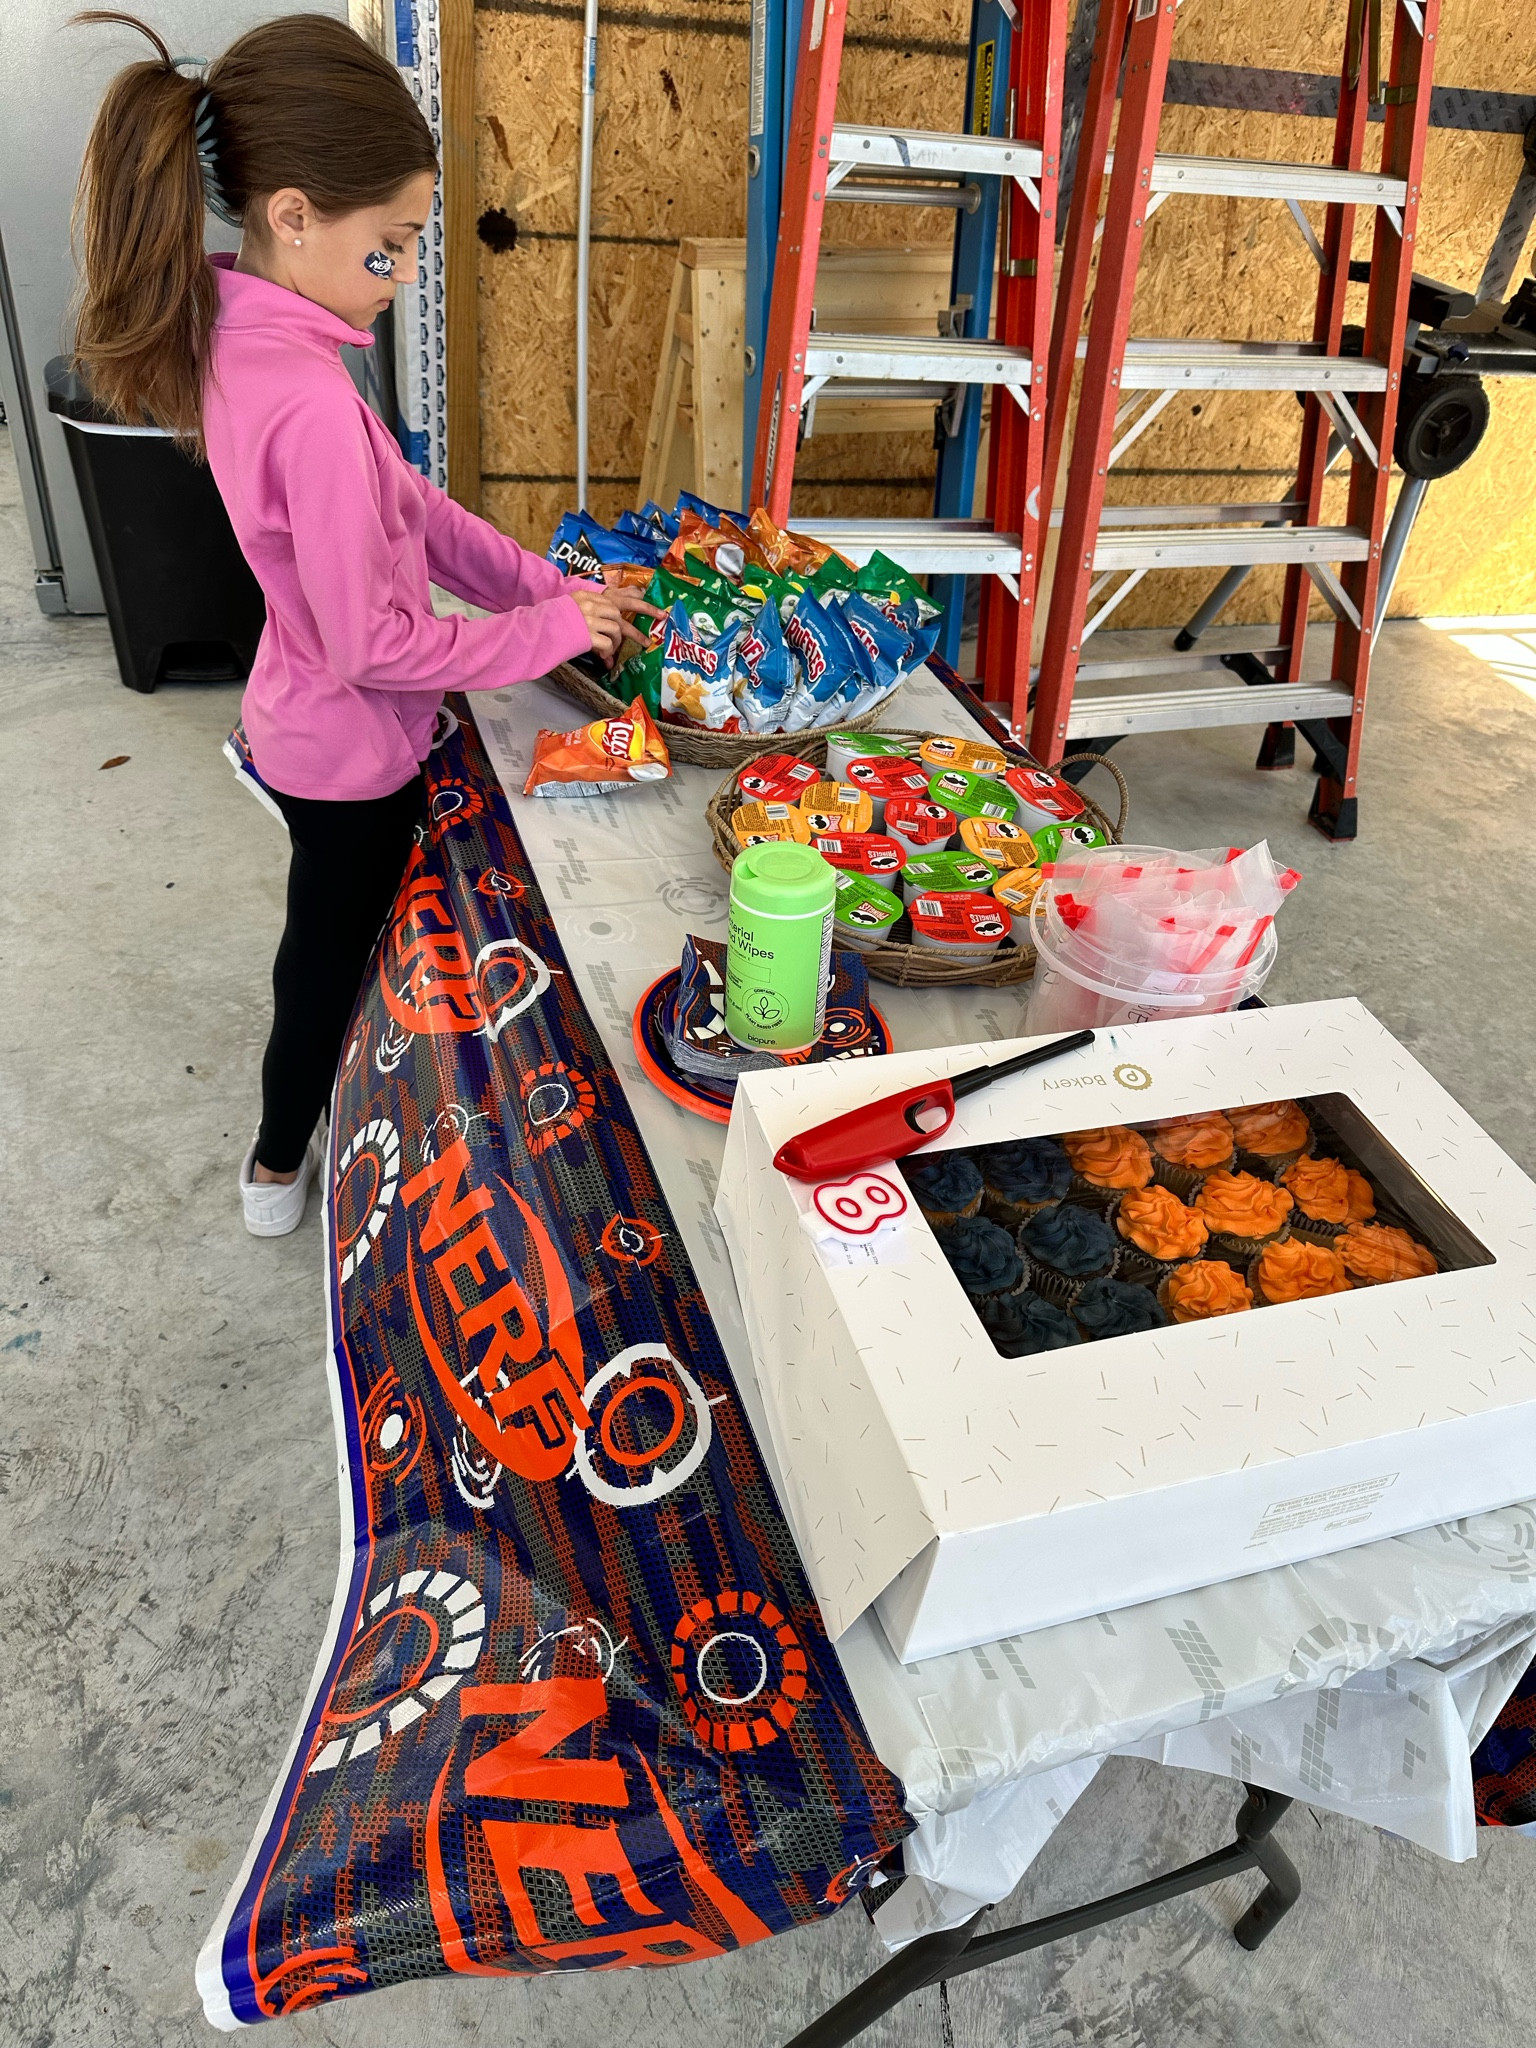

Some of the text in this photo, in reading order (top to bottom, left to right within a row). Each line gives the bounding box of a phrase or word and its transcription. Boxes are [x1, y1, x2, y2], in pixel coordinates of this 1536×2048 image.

[983, 52, 992, 128] CAUTION
[784, 615, 828, 683] RUFFLES
[937, 778, 966, 797] PRINGLES
[867, 850, 898, 859] PRINGLES
[858, 902, 890, 920] PRINGLES
[970, 913, 1002, 924] PRINGLES
[738, 936, 775, 960] Wipes
[1042, 1074, 1107, 1090] Bakery
[813, 1173, 907, 1235] 8
[400, 1138, 593, 1450] NERF
